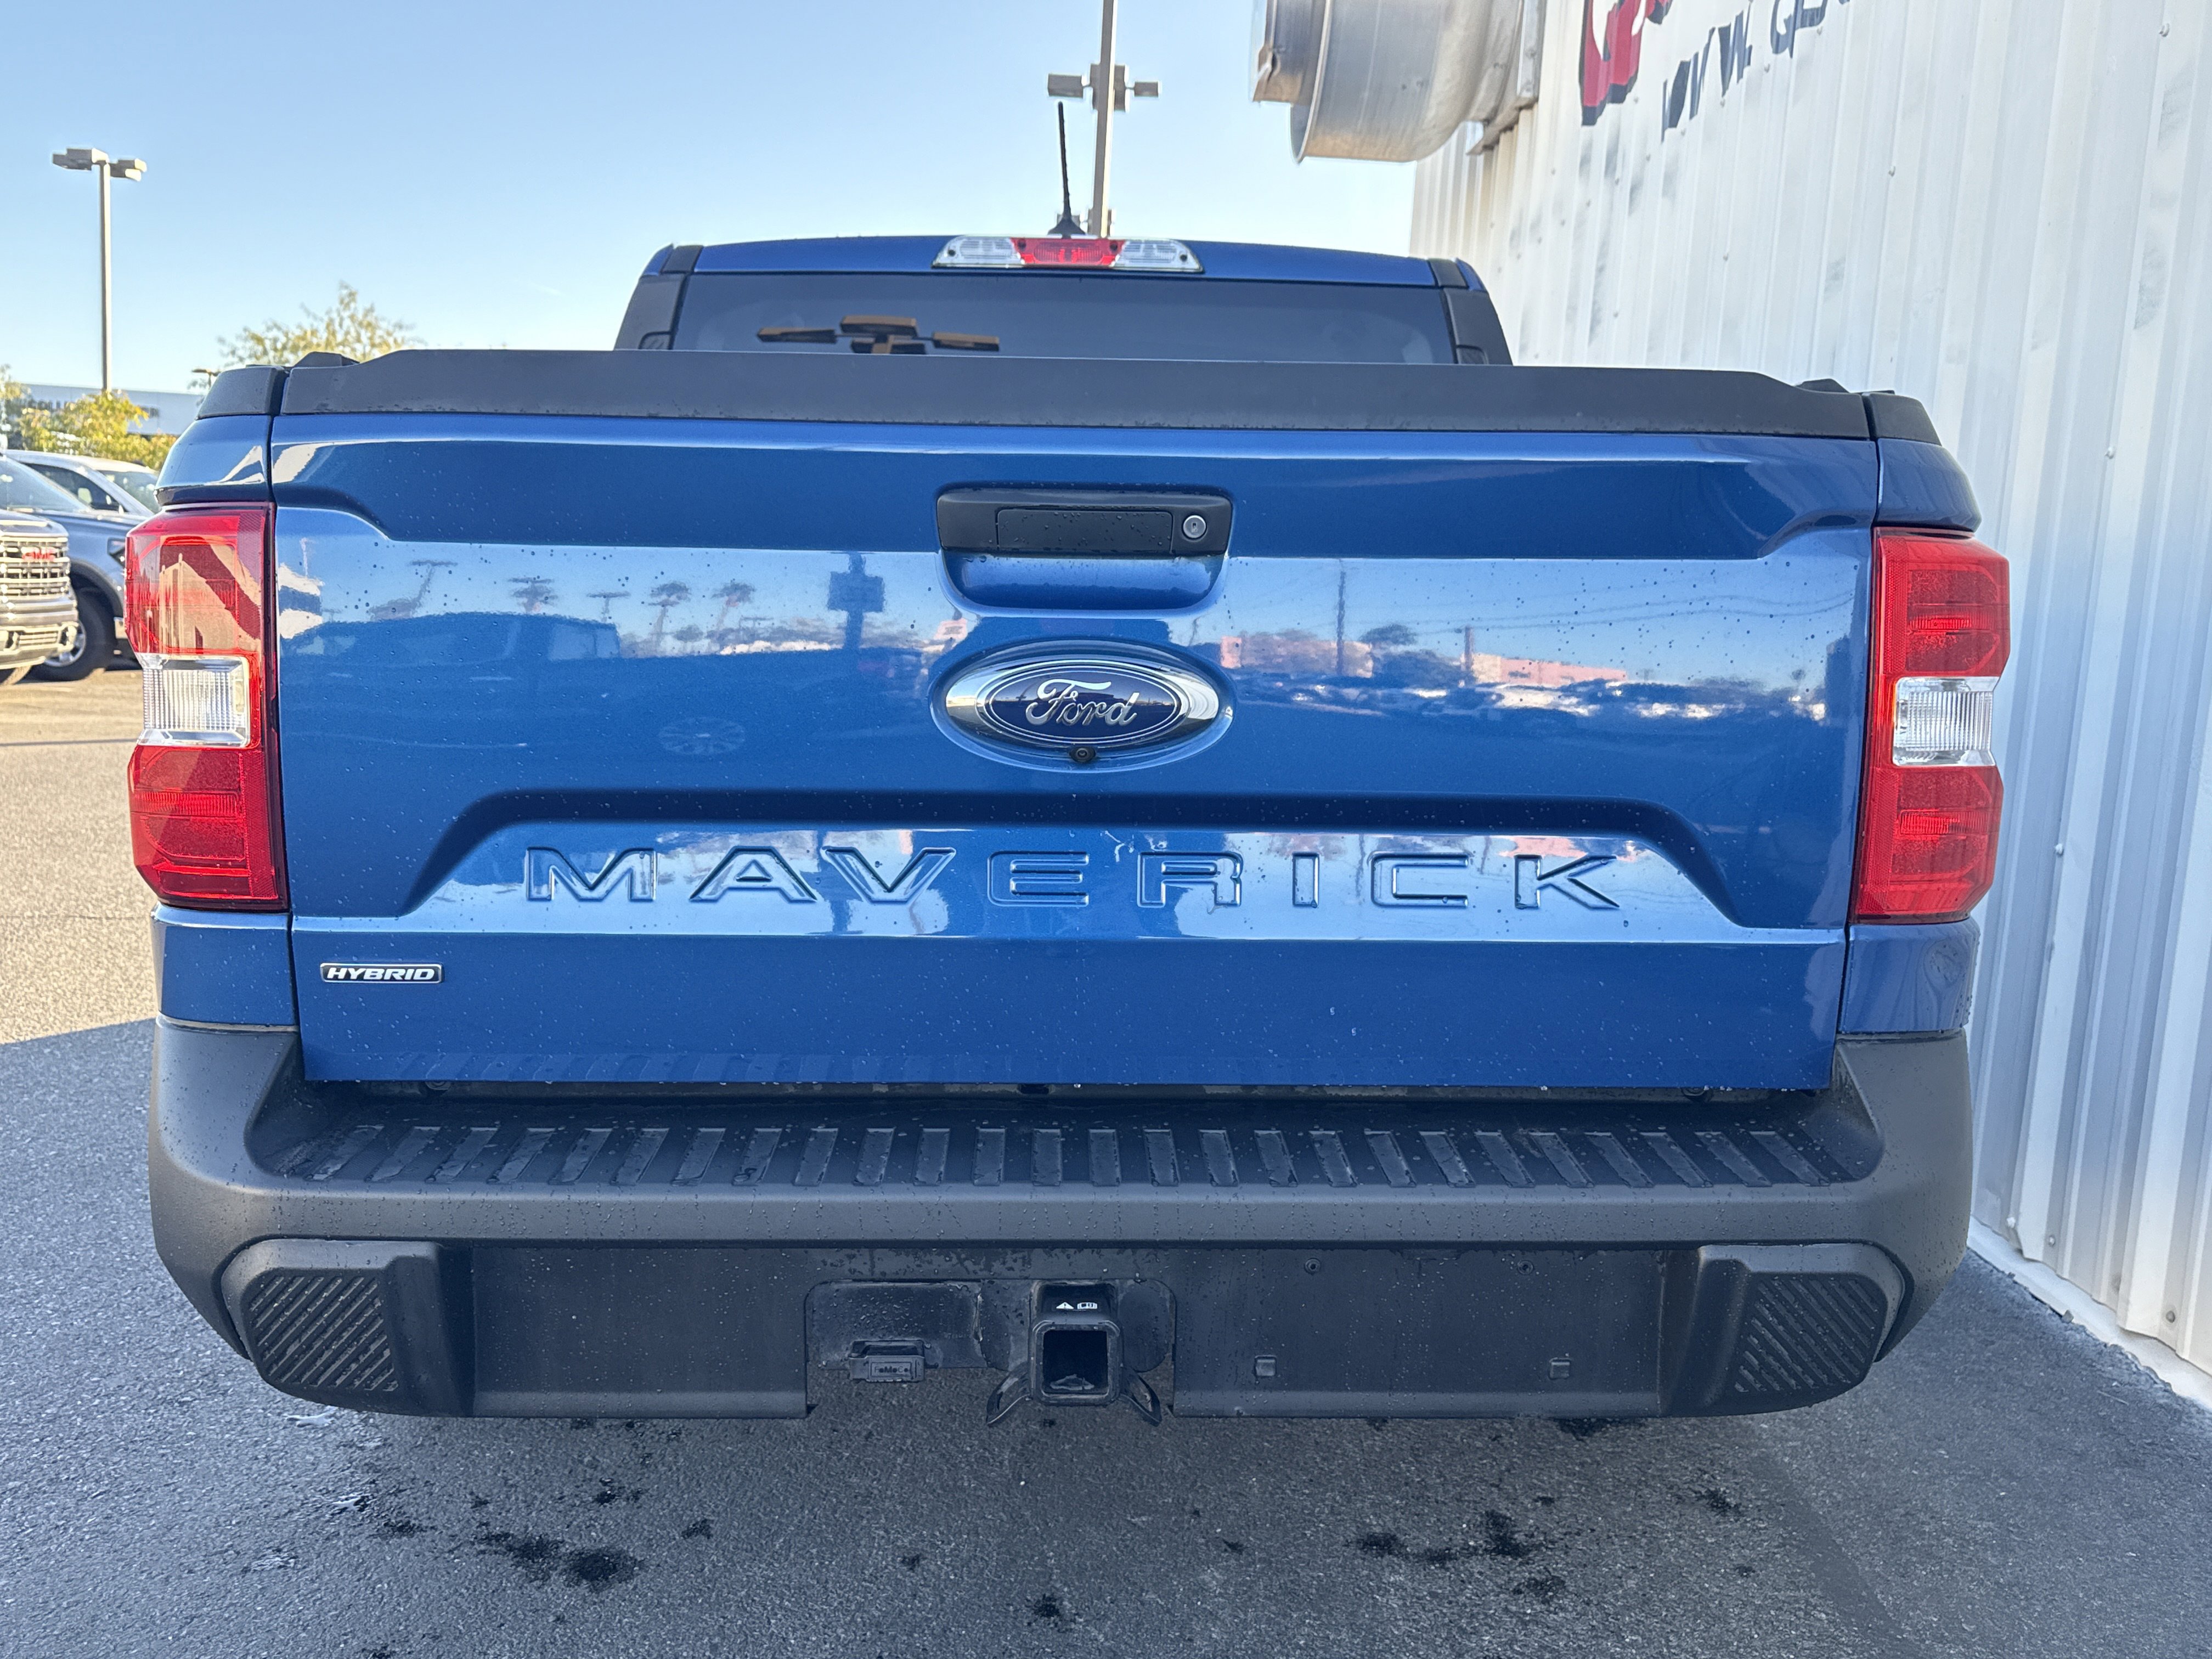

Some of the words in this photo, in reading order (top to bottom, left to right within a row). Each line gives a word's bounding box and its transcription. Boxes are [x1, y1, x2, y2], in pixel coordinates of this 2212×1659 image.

[1026, 678, 1140, 726] Ford
[524, 845, 1621, 909] MAVERICK
[327, 967, 435, 980] HYBRID
